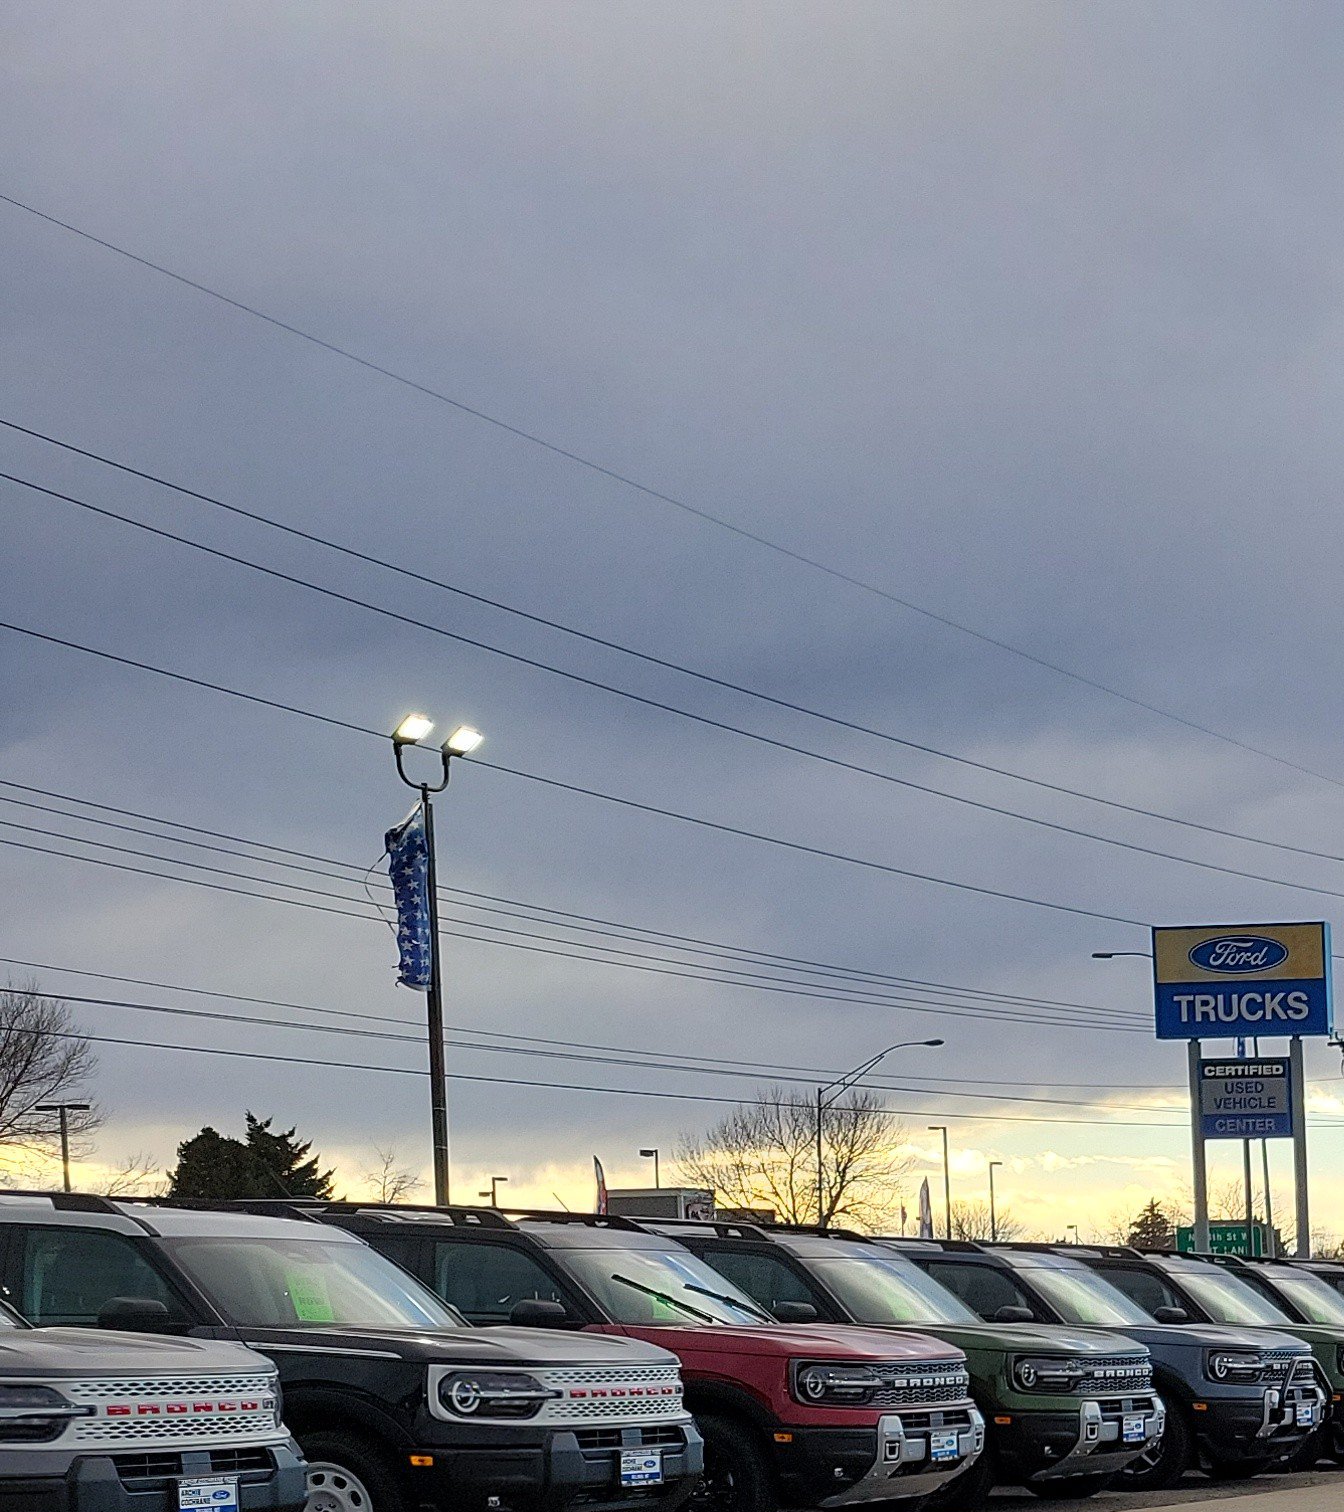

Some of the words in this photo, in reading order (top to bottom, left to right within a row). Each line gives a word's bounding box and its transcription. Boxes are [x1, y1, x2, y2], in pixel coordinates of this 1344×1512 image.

[1209, 941, 1268, 966] Ford
[1173, 991, 1309, 1023] TRUCKS
[1204, 1065, 1284, 1077] CERTIFIED
[1224, 1081, 1264, 1094] USED
[1213, 1097, 1276, 1110] VEHICLE
[1215, 1119, 1276, 1132] CENTER
[1226, 1232, 1237, 1241] St
[1094, 1368, 1149, 1378] BRONCO
[894, 1376, 963, 1387] BRONCO
[570, 1387, 673, 1399] BRONCO
[106, 1401, 258, 1415] BRONCO
